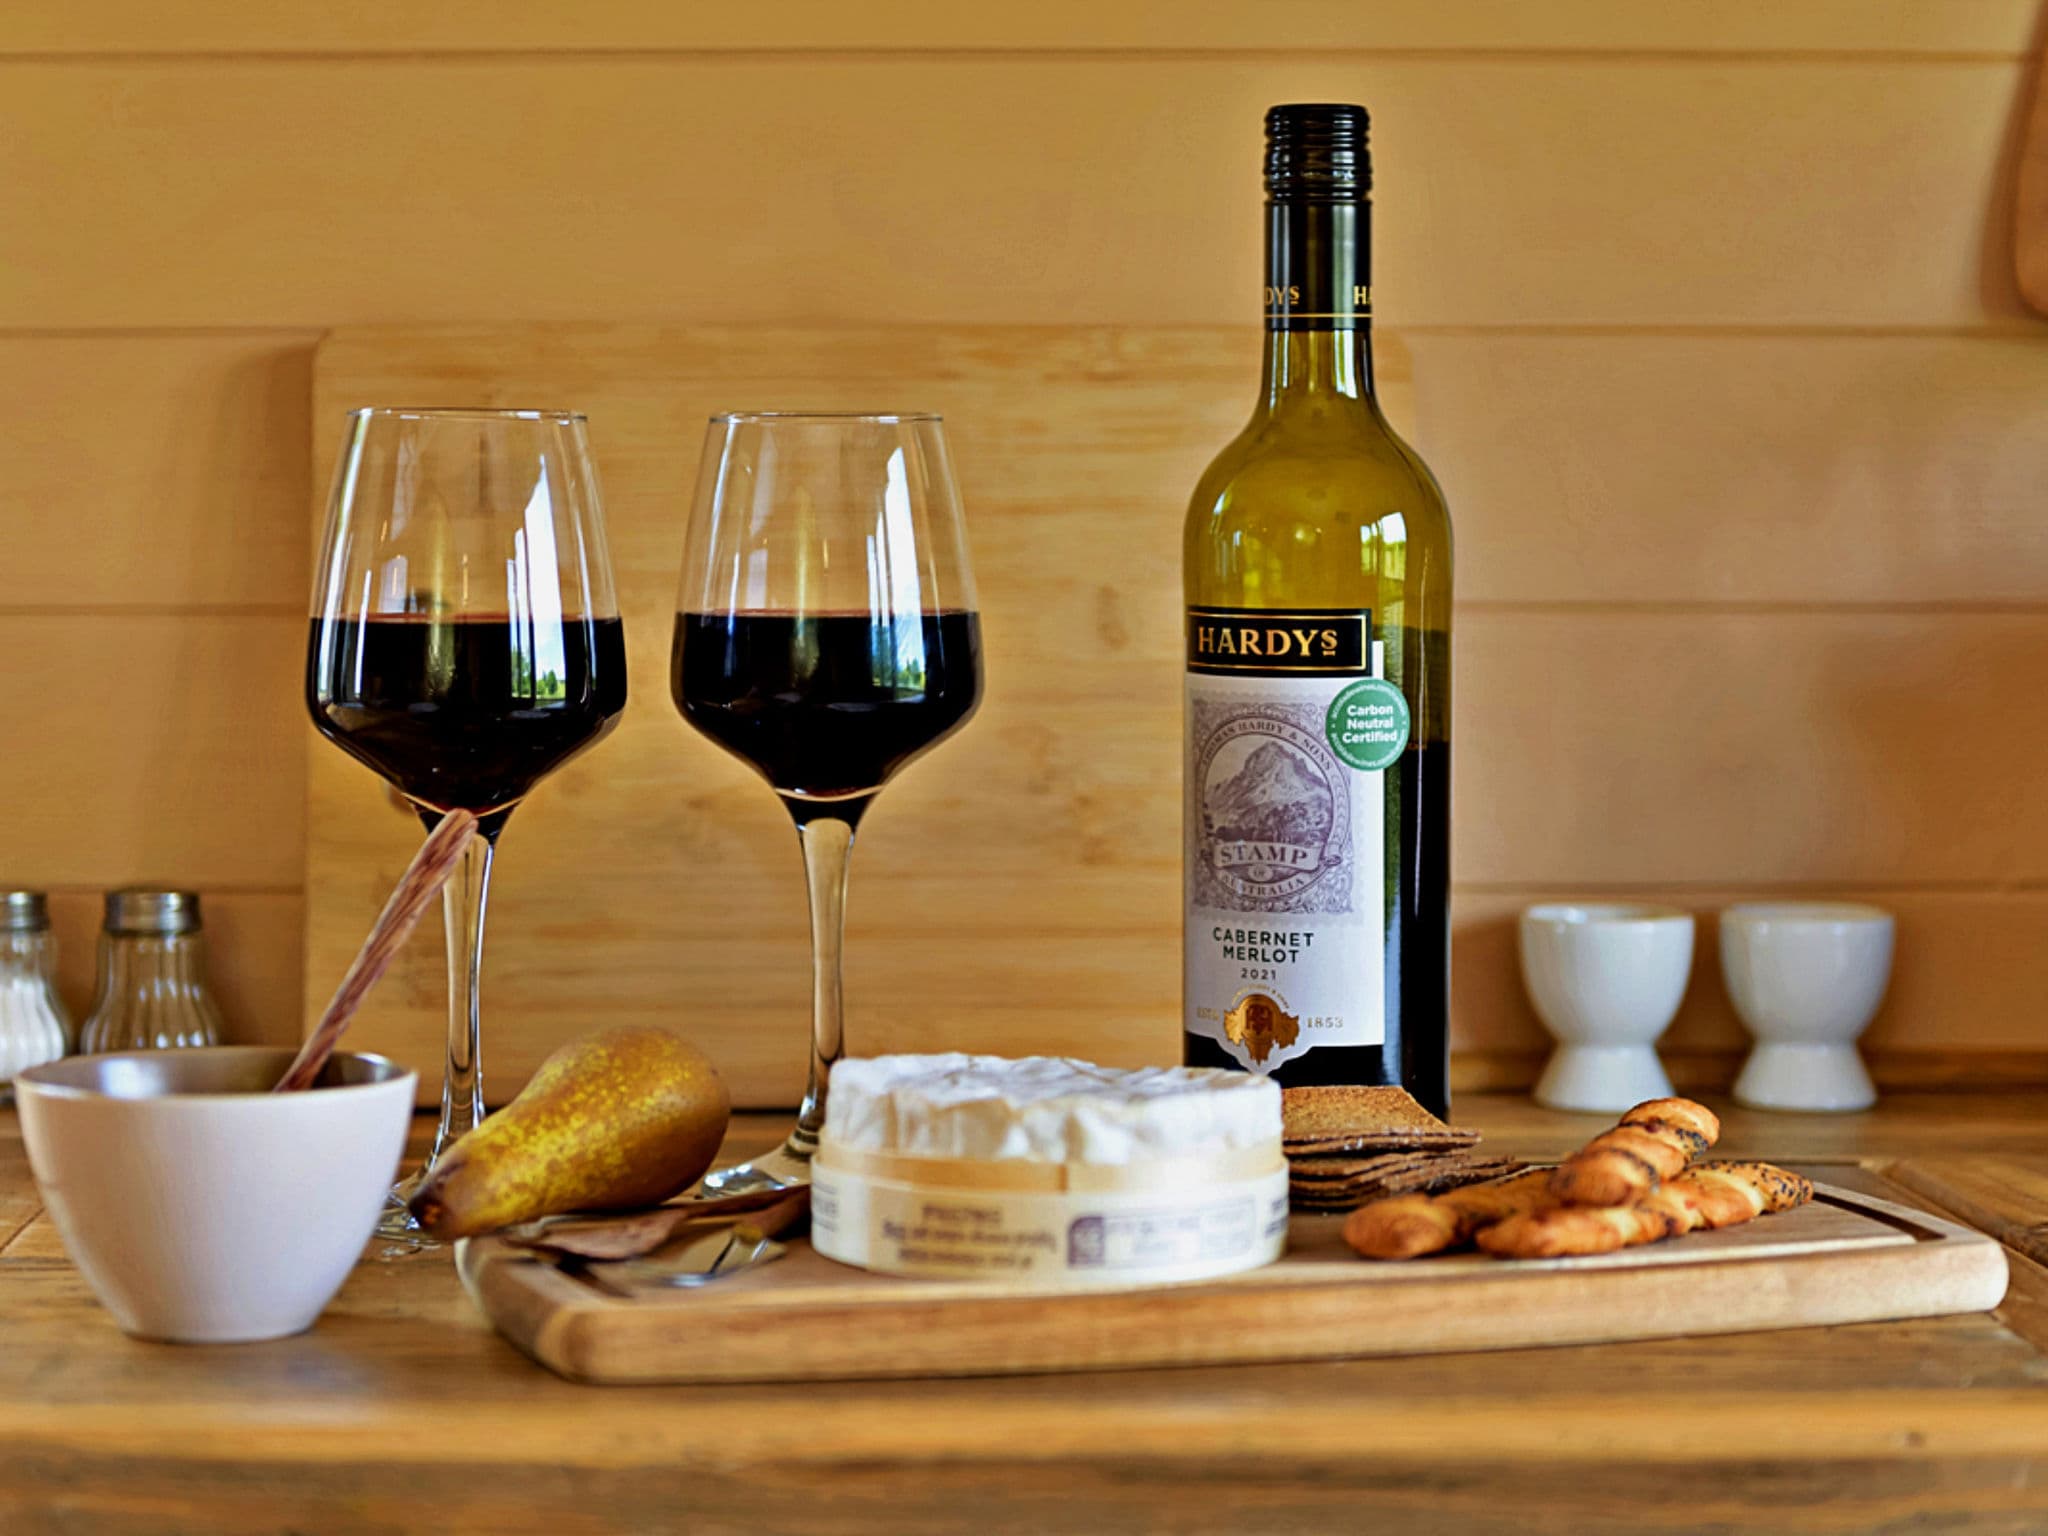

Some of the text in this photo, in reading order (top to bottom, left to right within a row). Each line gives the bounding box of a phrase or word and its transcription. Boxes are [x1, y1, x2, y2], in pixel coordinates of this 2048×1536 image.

[1347, 704, 1394, 717] Carbon
[1347, 717, 1394, 730] Neutral
[1342, 730, 1398, 744] Certified
[1237, 720, 1286, 735] HARDY
[1288, 731, 1299, 741] &
[1303, 738, 1331, 771] SONS
[1220, 843, 1308, 865] STAMP
[1212, 926, 1315, 947] CABERNET
[1222, 946, 1300, 964] MERLOT
[1240, 967, 1277, 981] 2021
[1306, 1016, 1344, 1029] 1853
